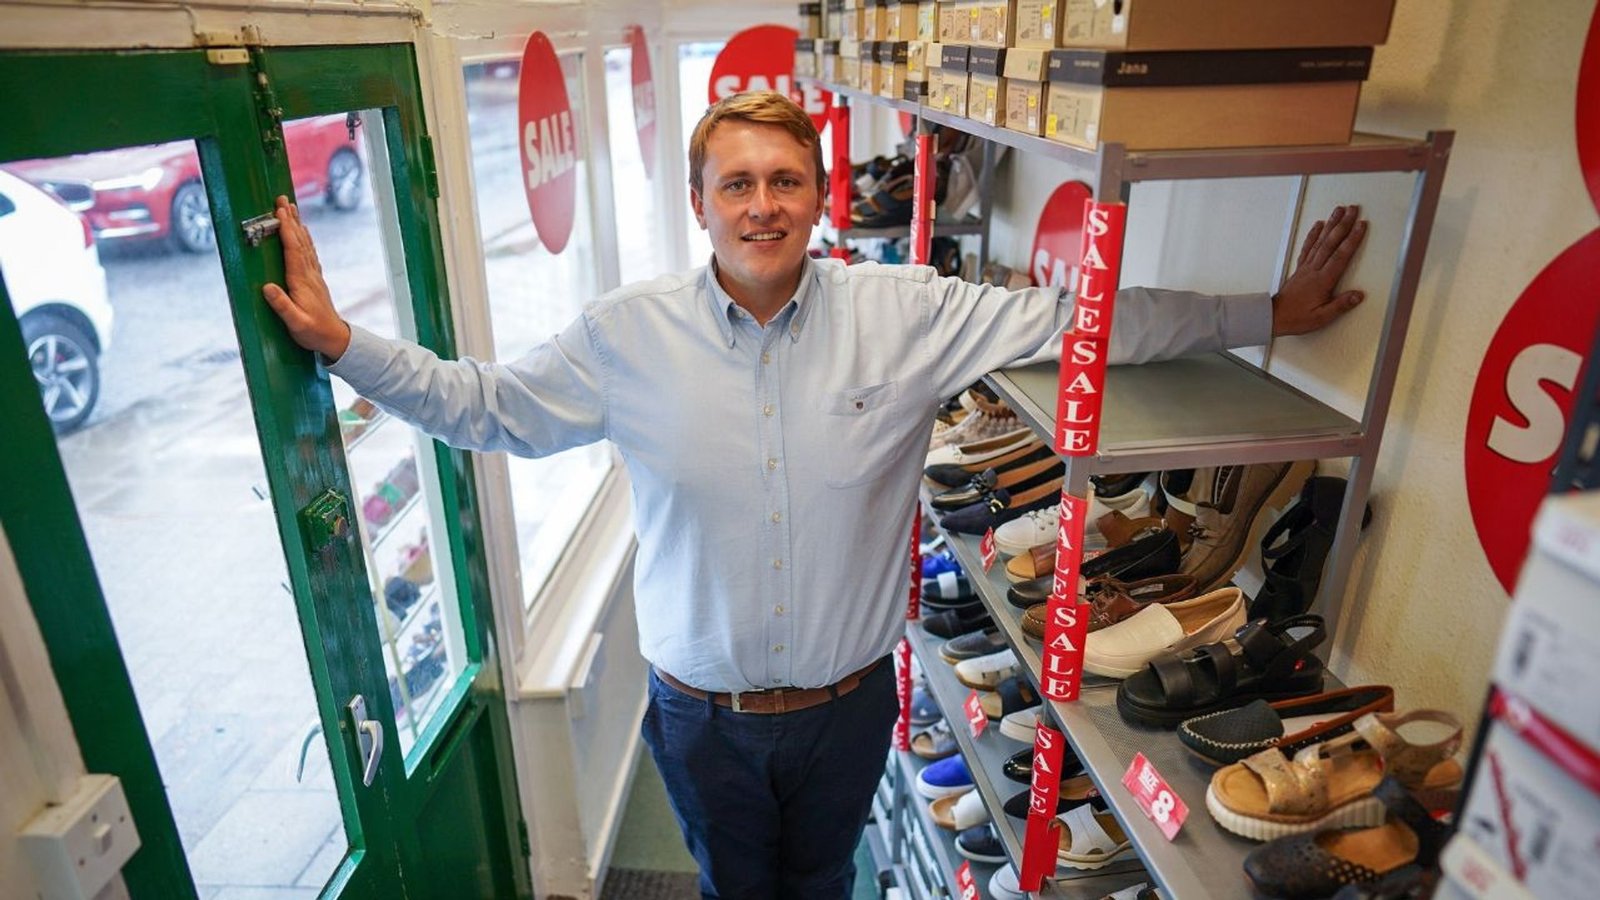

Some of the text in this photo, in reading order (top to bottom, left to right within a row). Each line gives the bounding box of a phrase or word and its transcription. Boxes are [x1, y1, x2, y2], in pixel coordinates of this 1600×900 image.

[525, 110, 574, 190] SALE
[1076, 208, 1109, 333] SALE
[1060, 340, 1097, 452] SALE
[1053, 497, 1073, 600] SALE
[1046, 607, 1077, 698] SALE
[1030, 728, 1053, 814] SALE
[1151, 789, 1175, 823] 8
